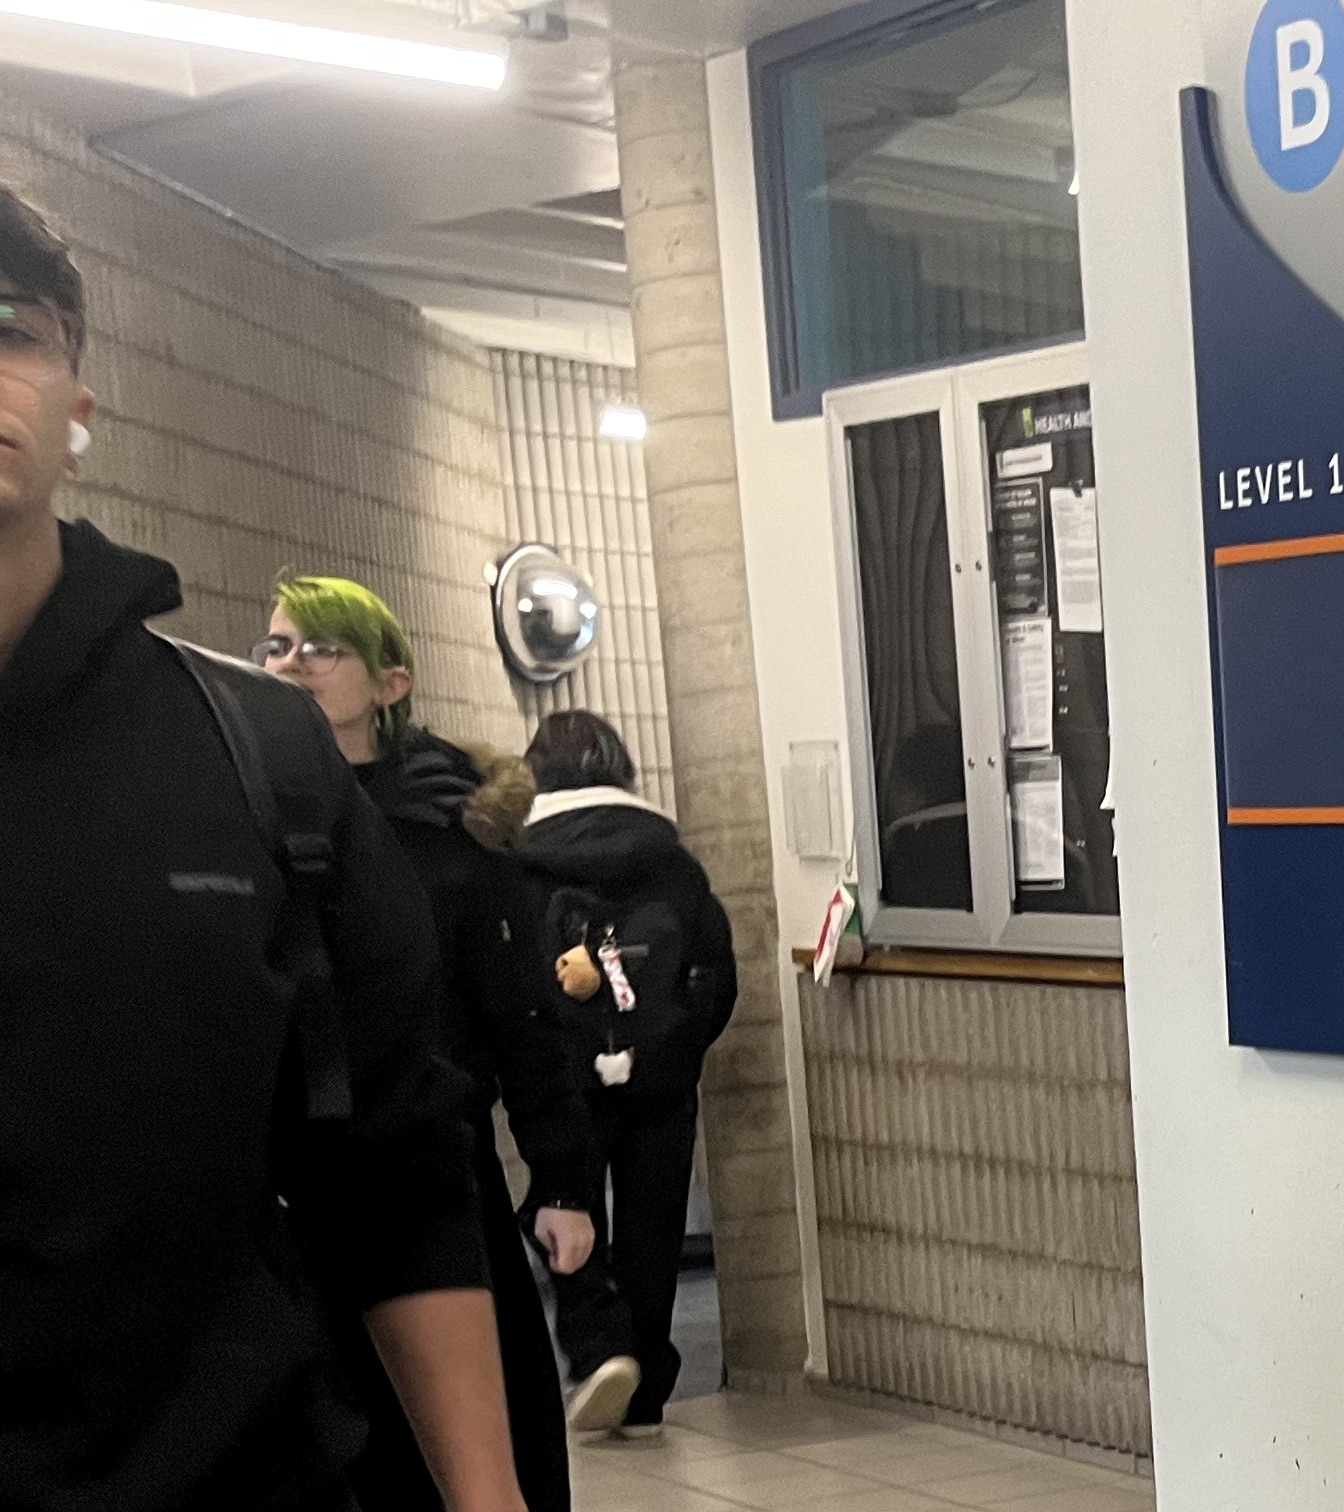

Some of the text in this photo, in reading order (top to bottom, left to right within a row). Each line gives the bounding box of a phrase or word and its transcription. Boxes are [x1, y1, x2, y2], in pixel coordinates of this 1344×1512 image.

[1275, 18, 1331, 152] B
[1219, 452, 1344, 511] LEVEL 1
